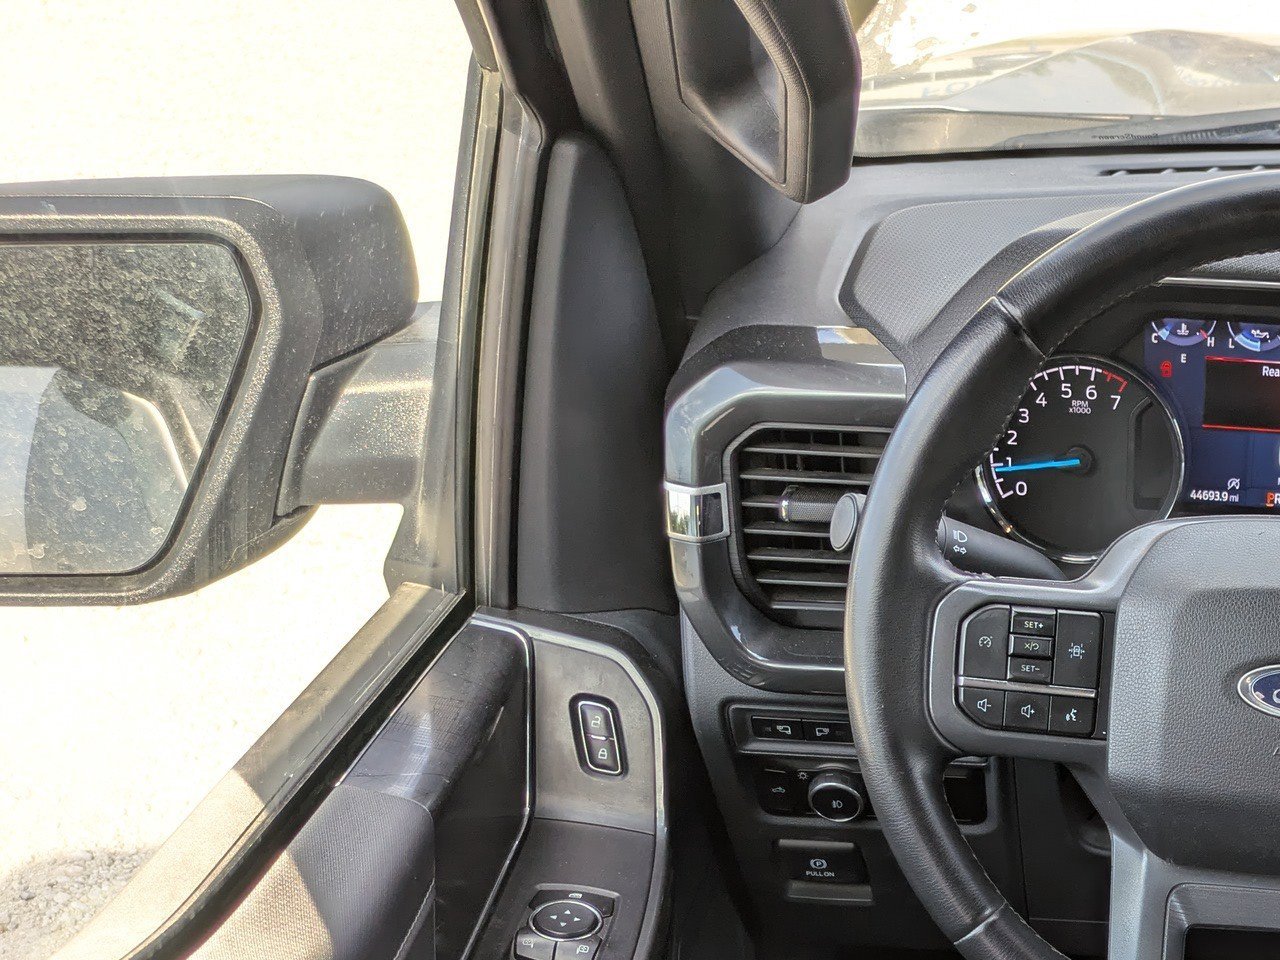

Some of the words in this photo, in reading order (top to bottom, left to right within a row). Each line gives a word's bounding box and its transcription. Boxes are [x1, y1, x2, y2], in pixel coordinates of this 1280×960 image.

[1152, 333, 1158, 343] C
[1207, 337, 1214, 348] H
[1229, 339, 1234, 348] L
[1181, 354, 1186, 363] E
[1061, 384, 1072, 398] 5
[1086, 385, 1097, 400] 6
[1036, 393, 1047, 407] 4
[1072, 400, 1089, 408] RPM
[1111, 395, 1121, 410] 7
[1019, 409, 1029, 423] 3
[1069, 407, 1091, 415] x1000
[1008, 431, 1018, 445] 2
[1016, 482, 1027, 496] 0
[1190, 490, 1228, 502] 44693.9
[1230, 494, 1239, 502] mi
